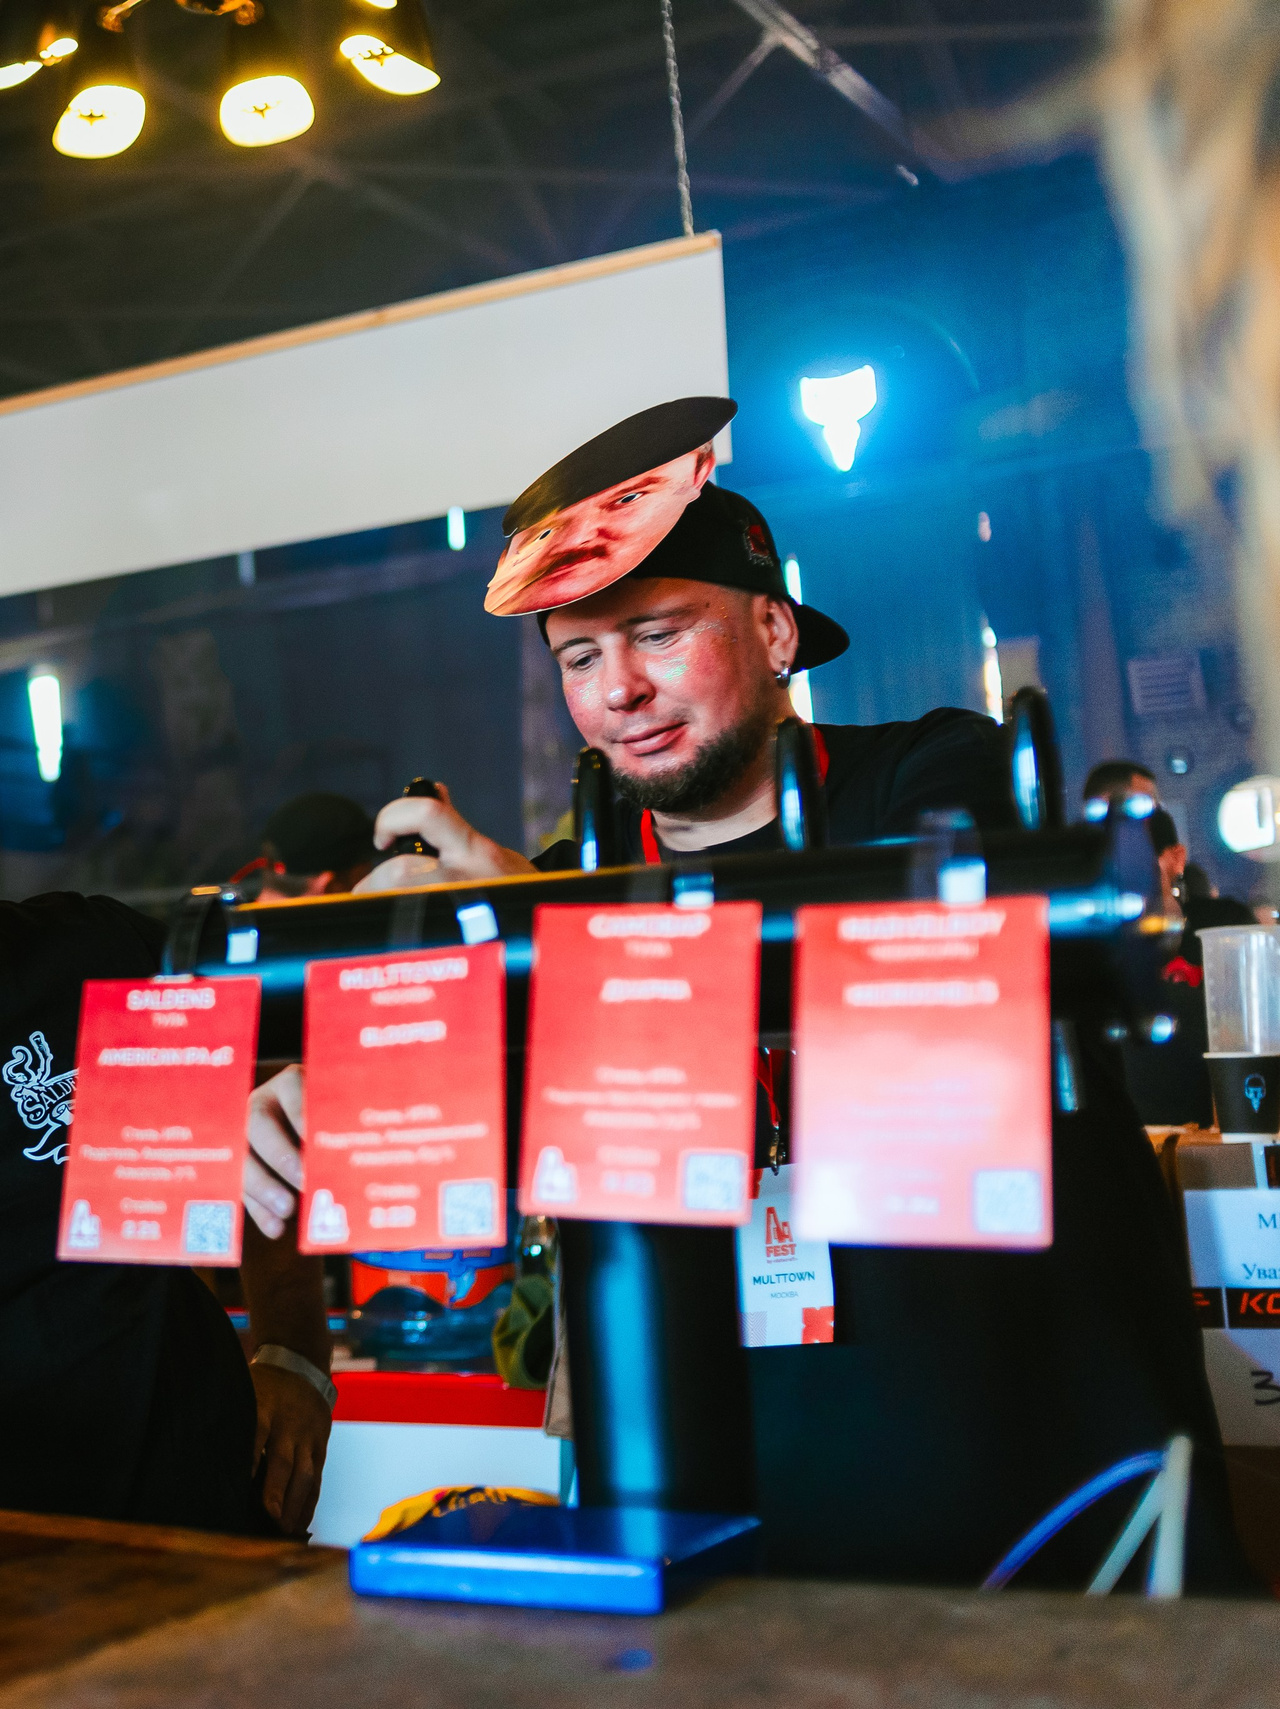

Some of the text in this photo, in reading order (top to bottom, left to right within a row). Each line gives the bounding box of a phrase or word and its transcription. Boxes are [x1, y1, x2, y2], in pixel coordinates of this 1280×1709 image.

[127, 988, 215, 1010] SALDENS
[766, 1243, 797, 1257] FEST
[753, 1271, 815, 1285] MULTTOWN
[1242, 1263, 1280, 1279] Ува
[770, 1291, 799, 1299] МОСКВА
